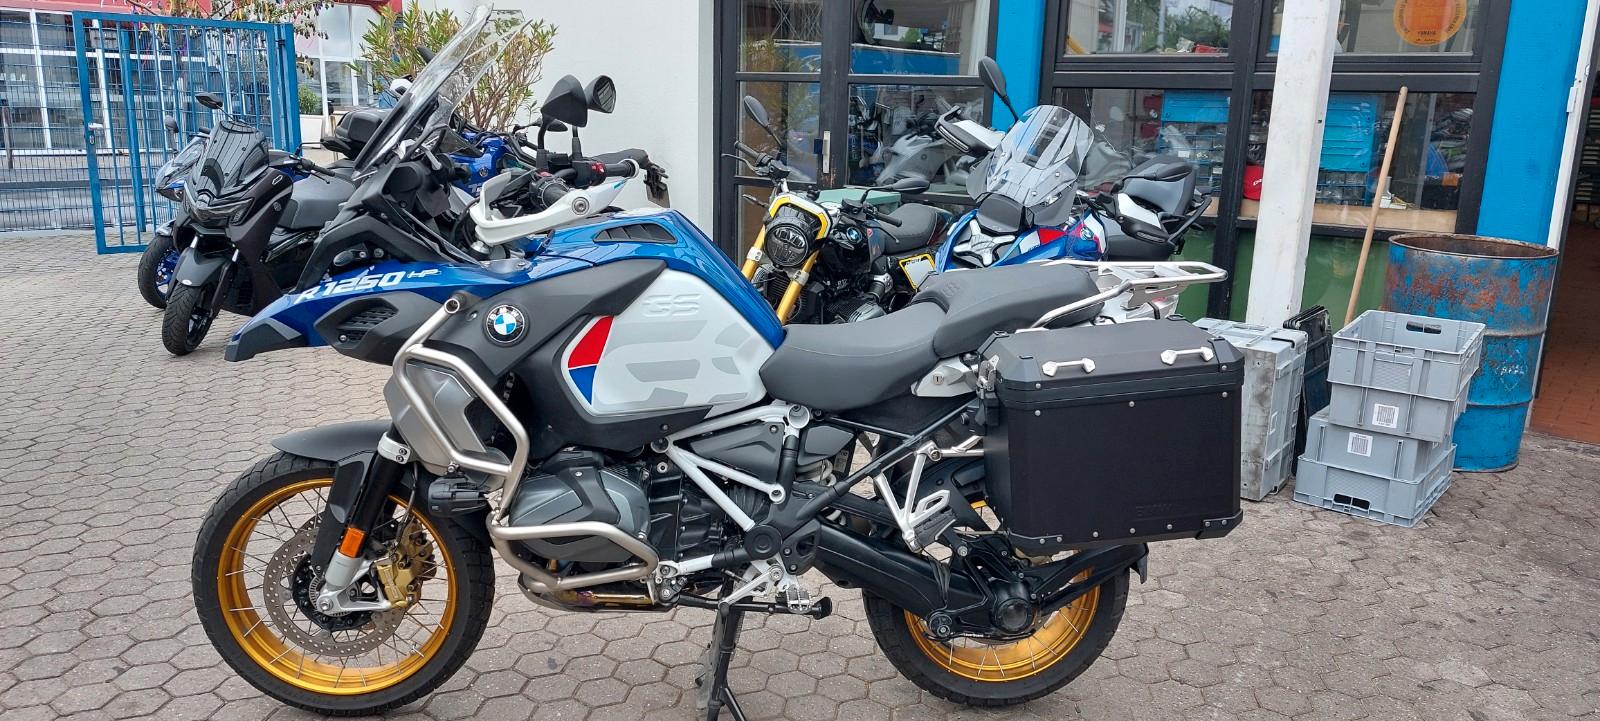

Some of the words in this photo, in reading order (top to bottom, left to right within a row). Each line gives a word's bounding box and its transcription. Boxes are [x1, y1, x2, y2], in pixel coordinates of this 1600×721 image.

[294, 285, 321, 304] R
[322, 271, 406, 296] 1250
[407, 268, 442, 279] HP
[641, 294, 702, 317] GS
